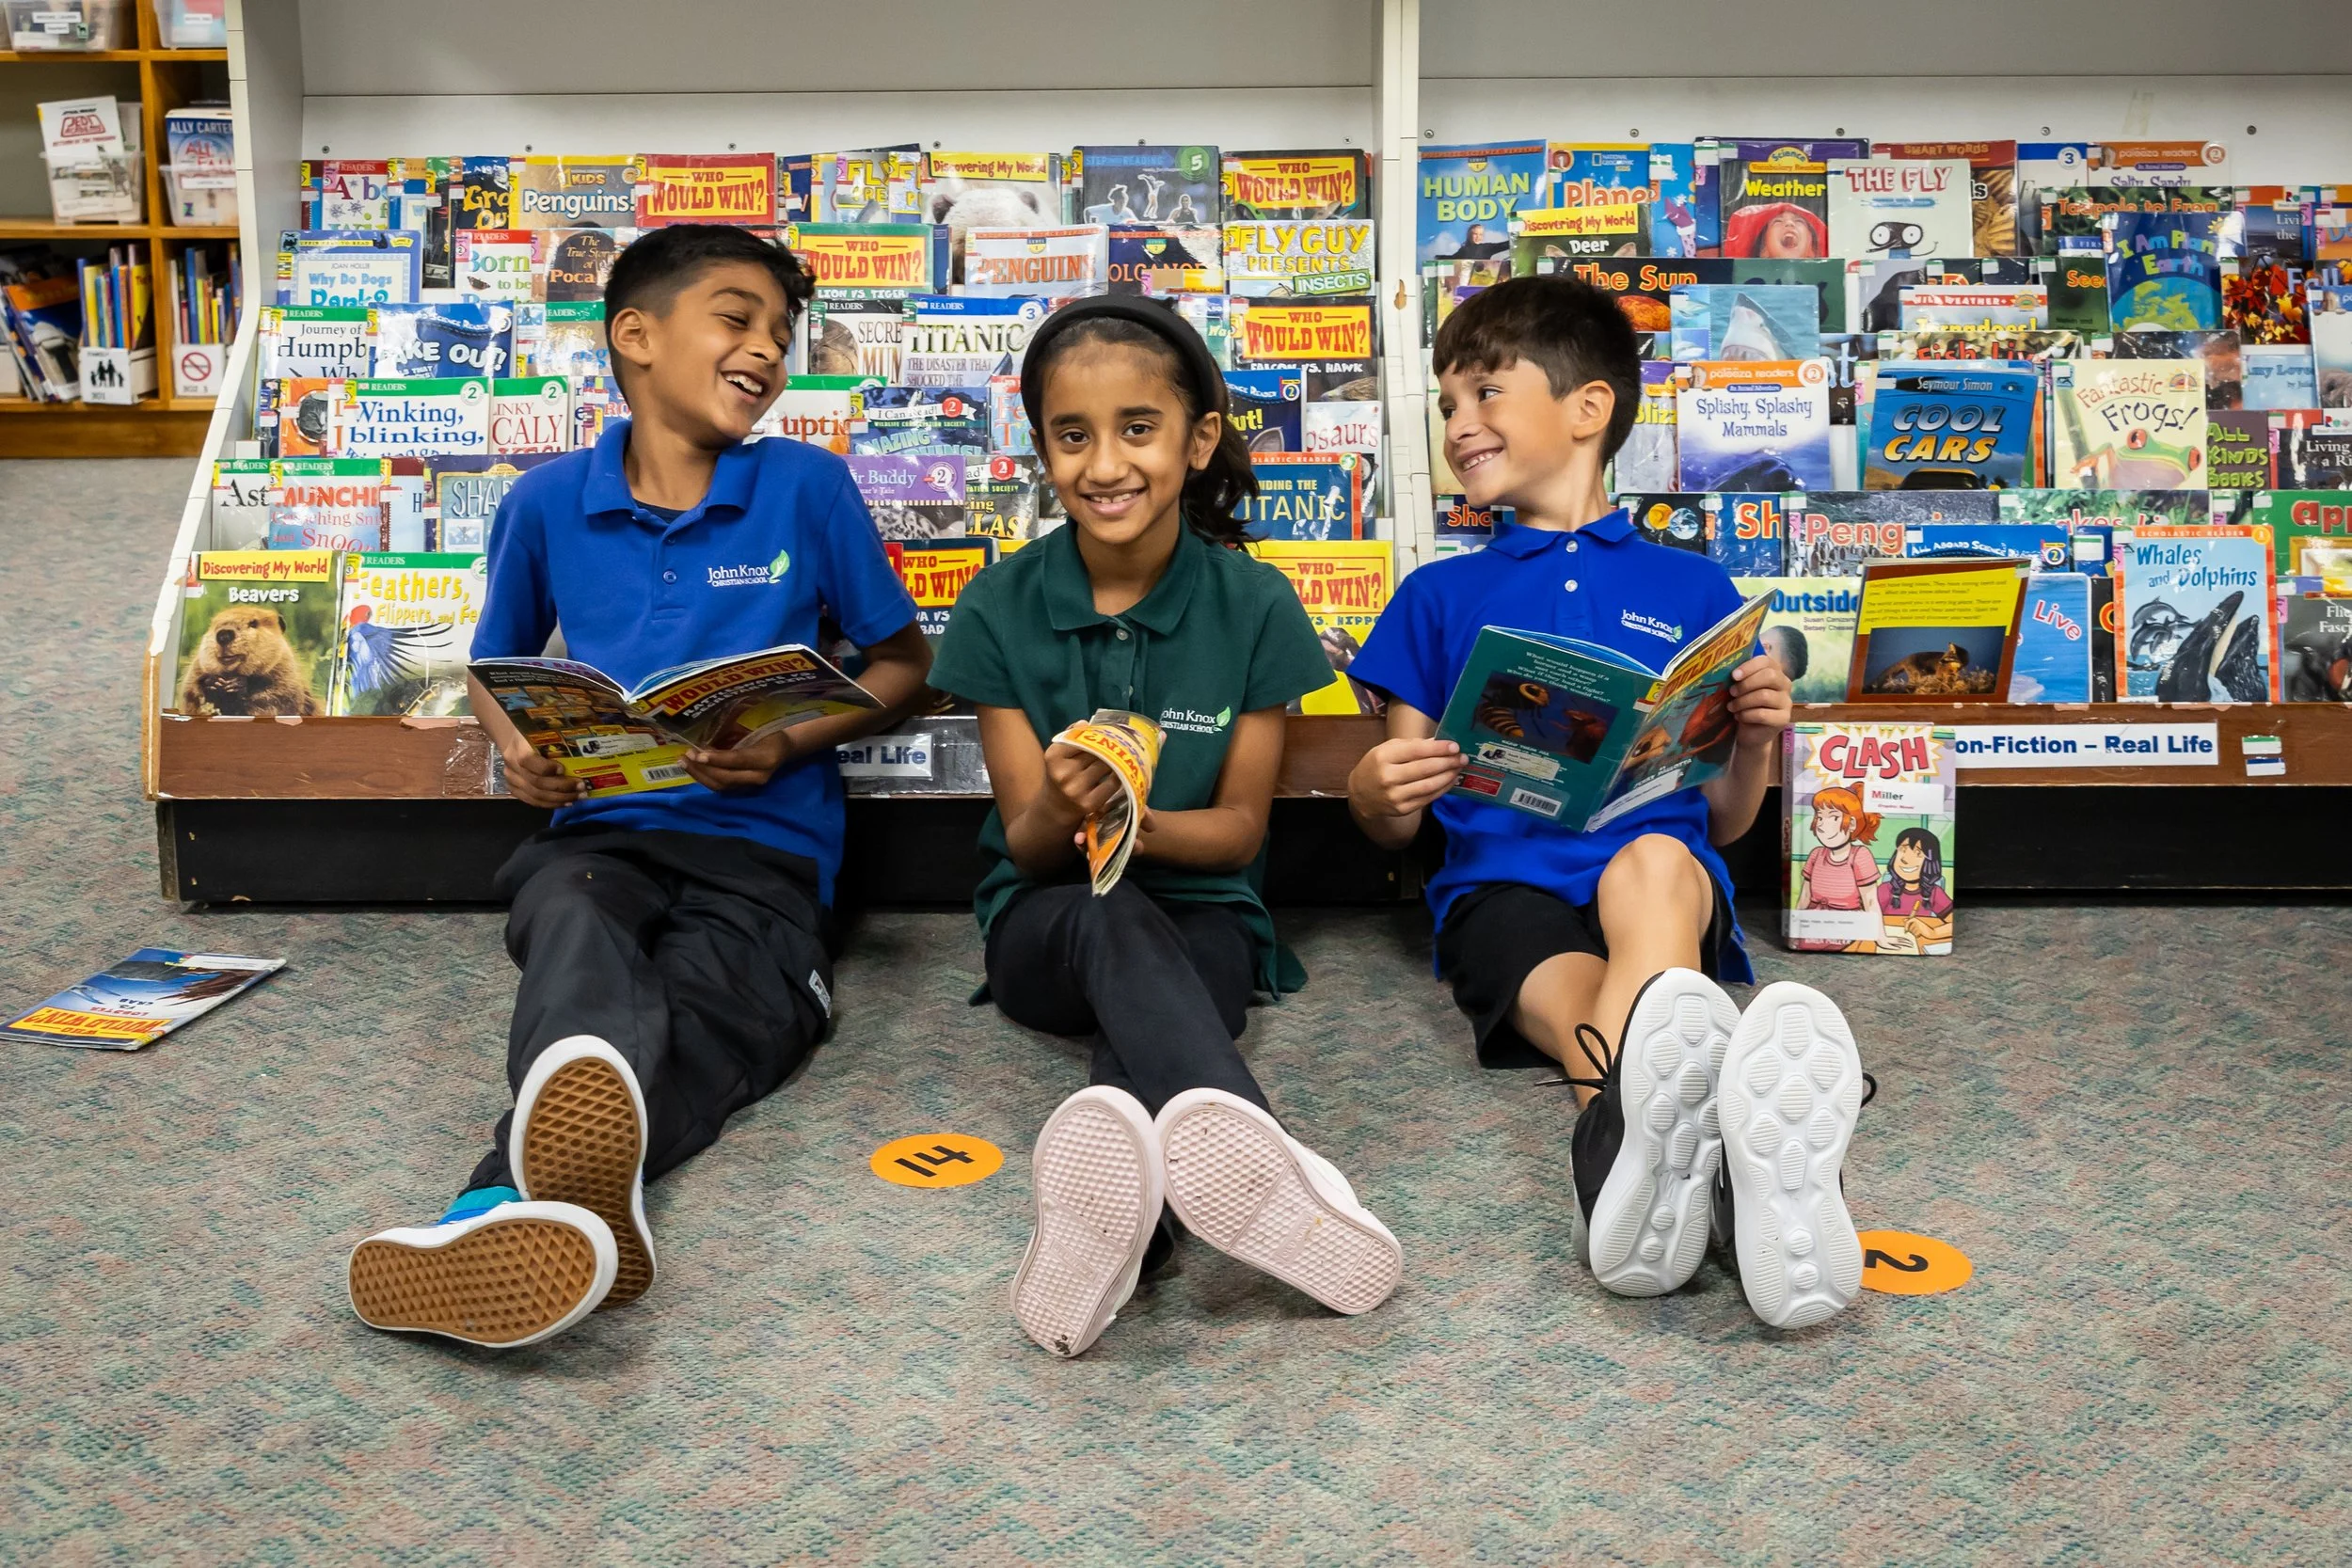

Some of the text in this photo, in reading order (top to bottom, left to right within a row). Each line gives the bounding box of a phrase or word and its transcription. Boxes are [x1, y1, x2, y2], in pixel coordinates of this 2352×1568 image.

[170, 121, 194, 134] ALLY
[1772, 150, 1806, 162] Science
[1903, 143, 1944, 156] SMART
[1190, 154, 1204, 171] 5
[2063, 152, 2074, 165] 3
[341, 163, 376, 172] READERS
[932, 158, 995, 178] Discovering
[996, 160, 1015, 179] My
[1278, 162, 1311, 174] WHO
[572, 173, 606, 185] KIDS
[692, 171, 724, 182] WHO
[1845, 166, 1897, 193] THE
[1901, 166, 1953, 192] FLY
[1236, 169, 1353, 203] WOULD WIN?
[1423, 172, 1531, 198] HUMAN
[1745, 179, 1827, 198] Weather
[522, 188, 636, 219] Penguins!
[651, 179, 766, 213] WOULD WIN?
[1438, 197, 1518, 222] BODY
[2145, 198, 2167, 213] to
[1604, 210, 1636, 227] World
[473, 232, 509, 241] READERS
[581, 235, 600, 246] The
[1239, 225, 1370, 255] FLY GUY
[2276, 230, 2296, 241] the
[847, 241, 880, 252] WHO
[1568, 239, 1610, 254] Deer
[2116, 234, 2169, 260] I Am
[871, 249, 923, 282] WIN?
[1247, 255, 1351, 274] PRESENTS
[2141, 254, 2204, 277] Earth
[309, 272, 392, 289] Why Do Dogs
[497, 278, 512, 290] to
[1297, 274, 1367, 293] INSECTS
[1573, 262, 1698, 291] The Sun
[818, 289, 907, 299] LION TIGER
[288, 309, 324, 318] READERS
[829, 302, 864, 310] READERS
[930, 302, 964, 310] READERS
[1025, 308, 1036, 320] 3
[1288, 311, 1323, 324] WHO
[300, 323, 361, 336] Journey of
[1246, 321, 1312, 355] WOULD
[1314, 320, 1368, 355] WIN?
[910, 323, 1027, 355] TITANIC
[907, 358, 925, 372] THE
[927, 357, 968, 372] DISASTER
[1325, 363, 1364, 373] HAWK
[1709, 368, 1795, 380] palooza readers
[371, 382, 407, 391] READERS
[1287, 387, 1295, 397] 2
[1916, 376, 1993, 392] Seymour Simon
[468, 387, 477, 399] 2
[548, 387, 557, 399] 2
[883, 409, 906, 420] Can
[948, 401, 957, 412] 2
[1755, 397, 1813, 420] Splashy
[1891, 404, 2006, 433] COOL
[2101, 401, 2201, 434] Frogs!
[349, 426, 485, 447] blinking,
[1722, 420, 1788, 437] Mammals
[2206, 421, 2250, 443] ALL
[1883, 435, 1997, 463] CARS
[2305, 440, 2350, 457] Living
[295, 461, 334, 471] READERS
[999, 463, 1008, 475] 2
[867, 469, 917, 491] Buddy
[936, 470, 946, 483] 2
[992, 485, 1020, 494] SOCIETY
[1297, 480, 1318, 491] THE
[1804, 513, 1905, 556] Peng
[2140, 530, 2246, 538] SCHOLASTIC READER
[1911, 546, 1931, 557] ALL
[1933, 541, 1970, 553] ABOARD
[2051, 550, 2058, 562] 2
[2137, 544, 2202, 566] Whales
[202, 557, 328, 578] Discovering My World
[366, 556, 406, 565] READERS
[902, 556, 937, 568] WHO
[1296, 562, 1334, 575] WHO
[707, 564, 770, 583] John Knox
[2148, 566, 2258, 591] and Dolphins
[228, 586, 300, 603] Beavers
[1327, 572, 1382, 610] WIN?
[374, 605, 455, 626] Flippers, and
[1621, 609, 1674, 634] John Knox
[2032, 599, 2083, 641] Live
[661, 657, 810, 712] WOULD WIN?
[1185, 709, 1216, 724] Knox
[1955, 736, 2214, 754] on-Fiction Real Life
[880, 745, 928, 765] Life
[1820, 735, 1930, 779] CLASH
[1871, 790, 1904, 800] Miller
[894, 1145, 976, 1178] 14
[1864, 1248, 1930, 1273] 2
